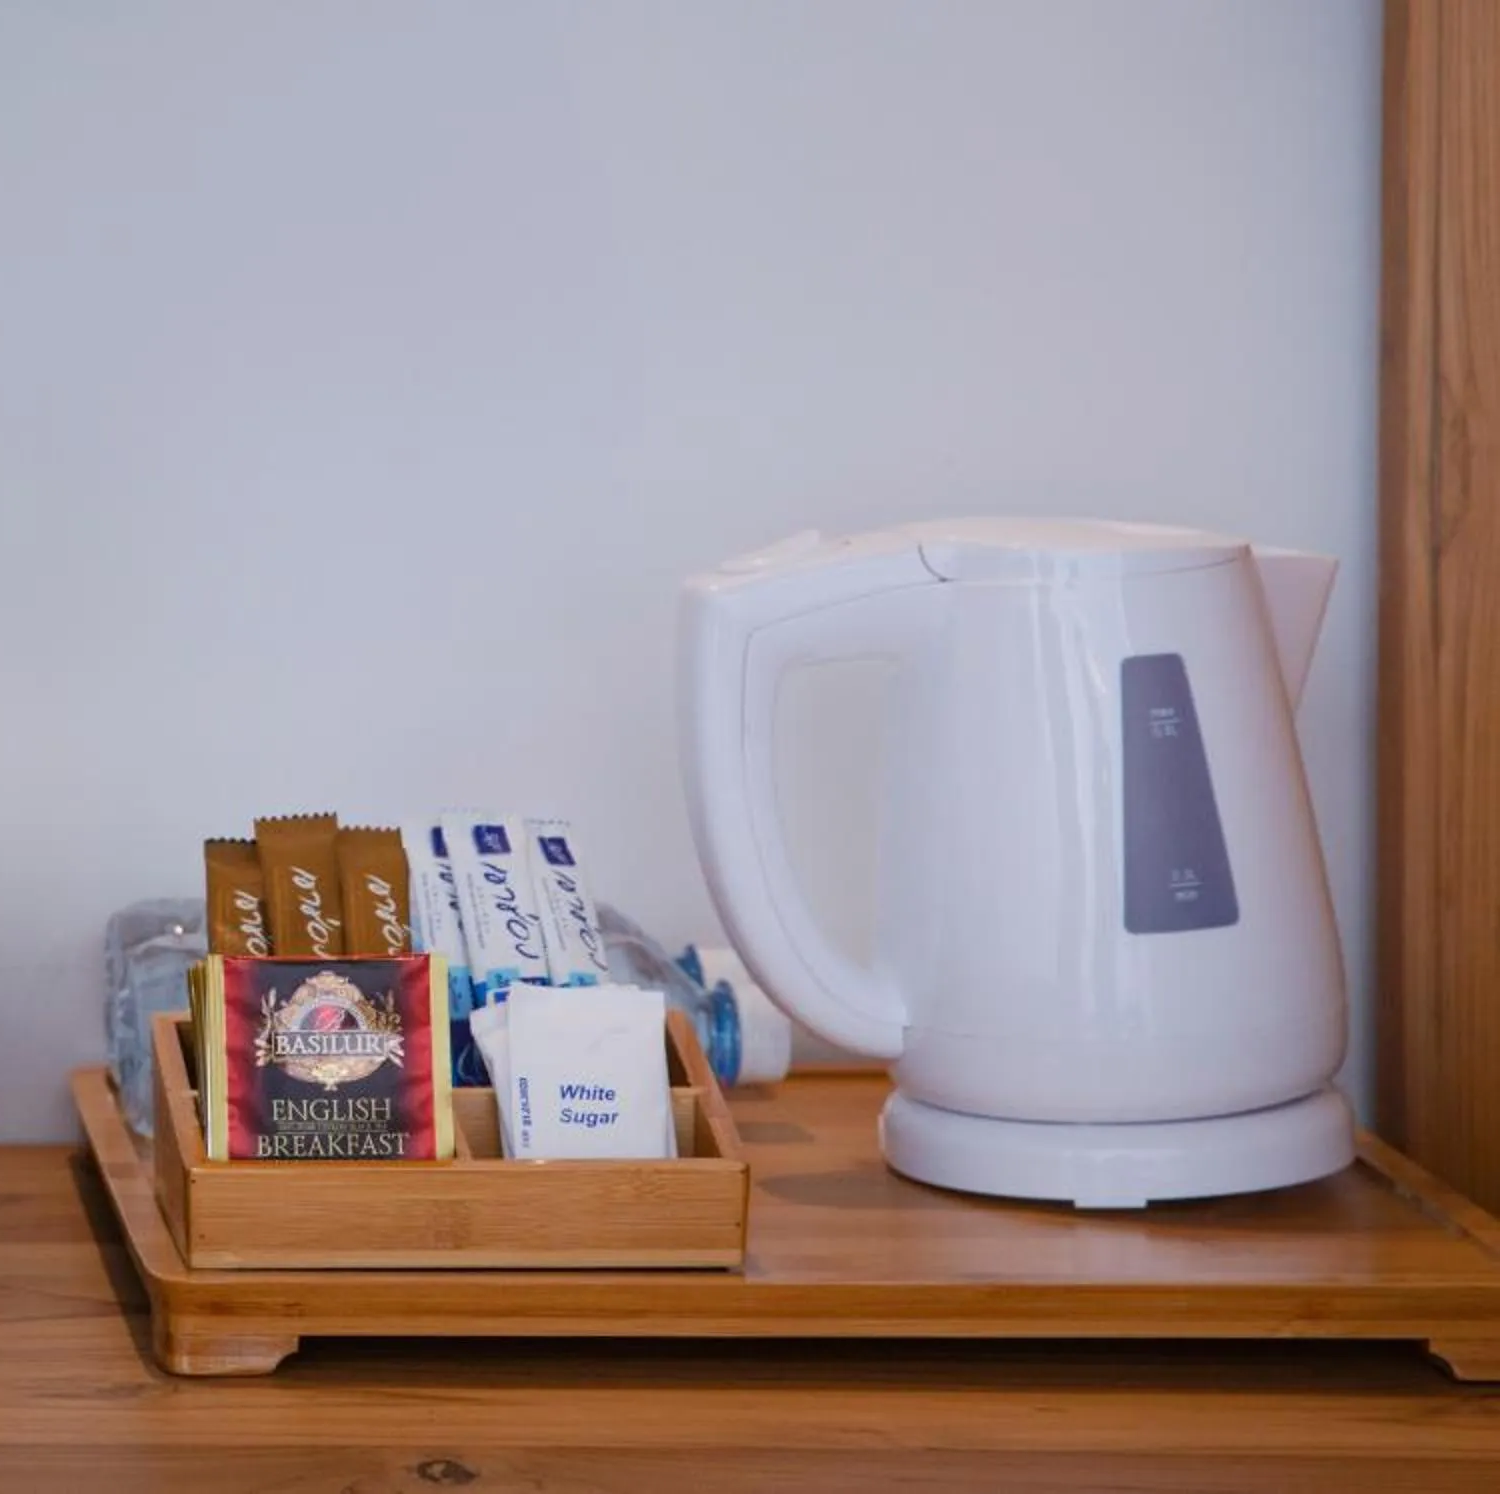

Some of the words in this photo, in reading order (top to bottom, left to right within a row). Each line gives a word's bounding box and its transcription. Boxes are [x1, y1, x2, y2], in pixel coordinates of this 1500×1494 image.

[275, 1034, 381, 1055] BASILUR
[560, 1084, 617, 1102] White
[272, 1099, 392, 1122] ENGLISH
[559, 1107, 619, 1128] Sugar
[257, 1132, 410, 1157] BREAKFAST
